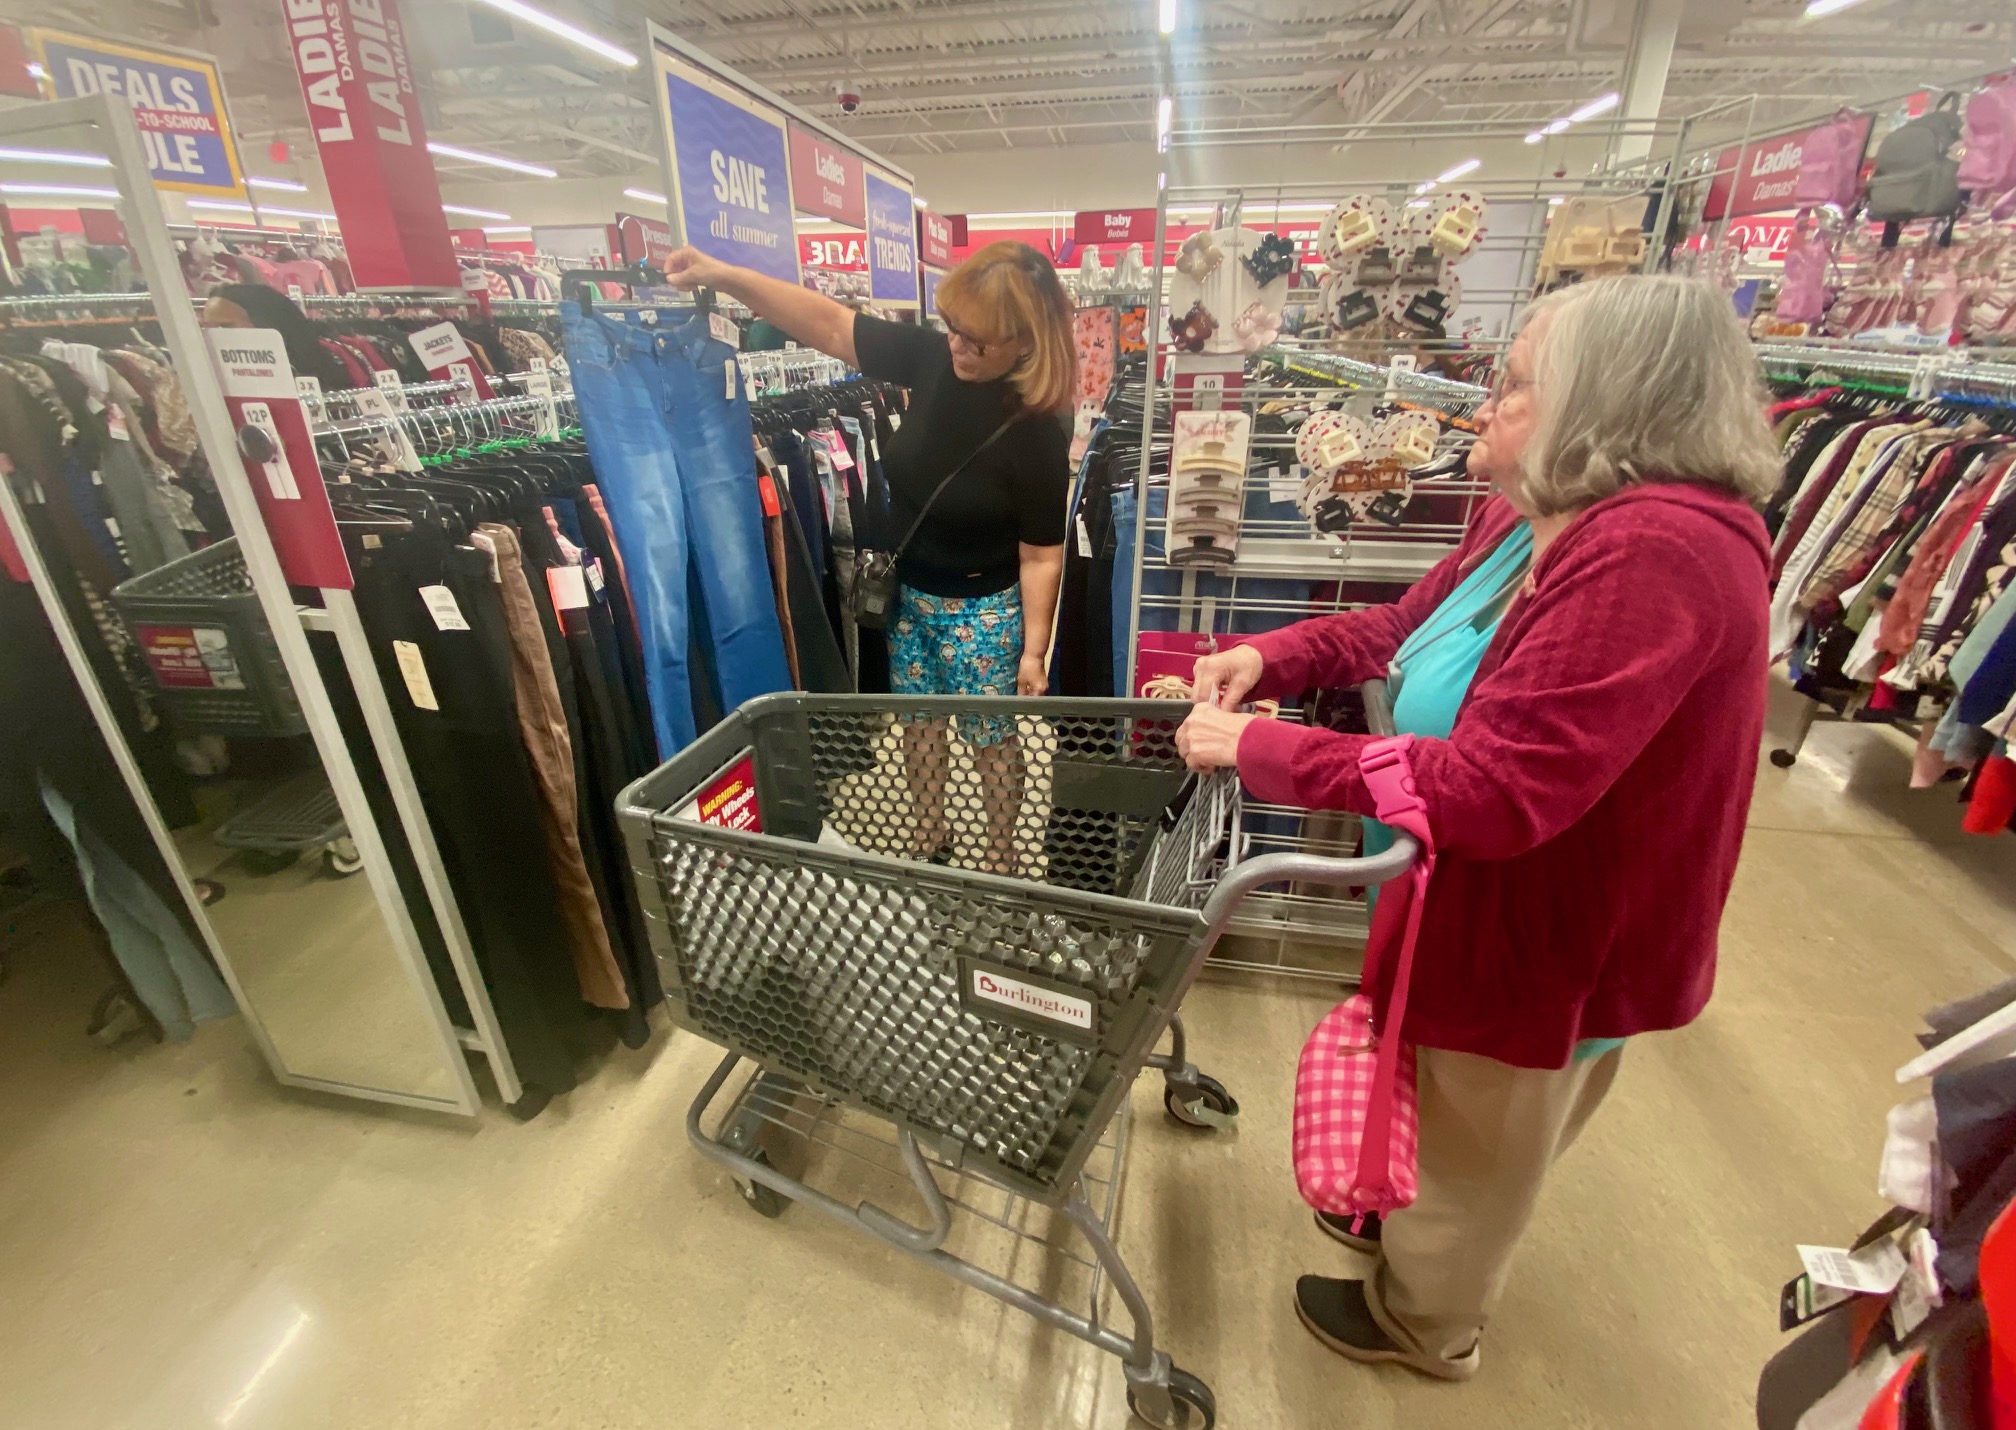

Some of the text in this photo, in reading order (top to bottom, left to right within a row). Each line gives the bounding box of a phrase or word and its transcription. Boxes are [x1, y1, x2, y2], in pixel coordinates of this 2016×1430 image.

[326, 2, 354, 81] DAMAS
[387, 18, 413, 94] DAMAS
[66, 57, 200, 114] DEALS
[710, 149, 770, 215] SAVE
[815, 147, 845, 186] Ladies
[710, 210, 779, 249] all summer
[1104, 213, 1132, 227] Baby
[874, 236, 912, 274] TRENDS
[220, 349, 276, 365] BOTTOMS
[423, 335, 454, 351] JACKETS
[1203, 380, 1216, 389] 10
[703, 781, 742, 817] WARNING:
[721, 786, 755, 820] Wheels
[979, 976, 1085, 1019] Burlington
